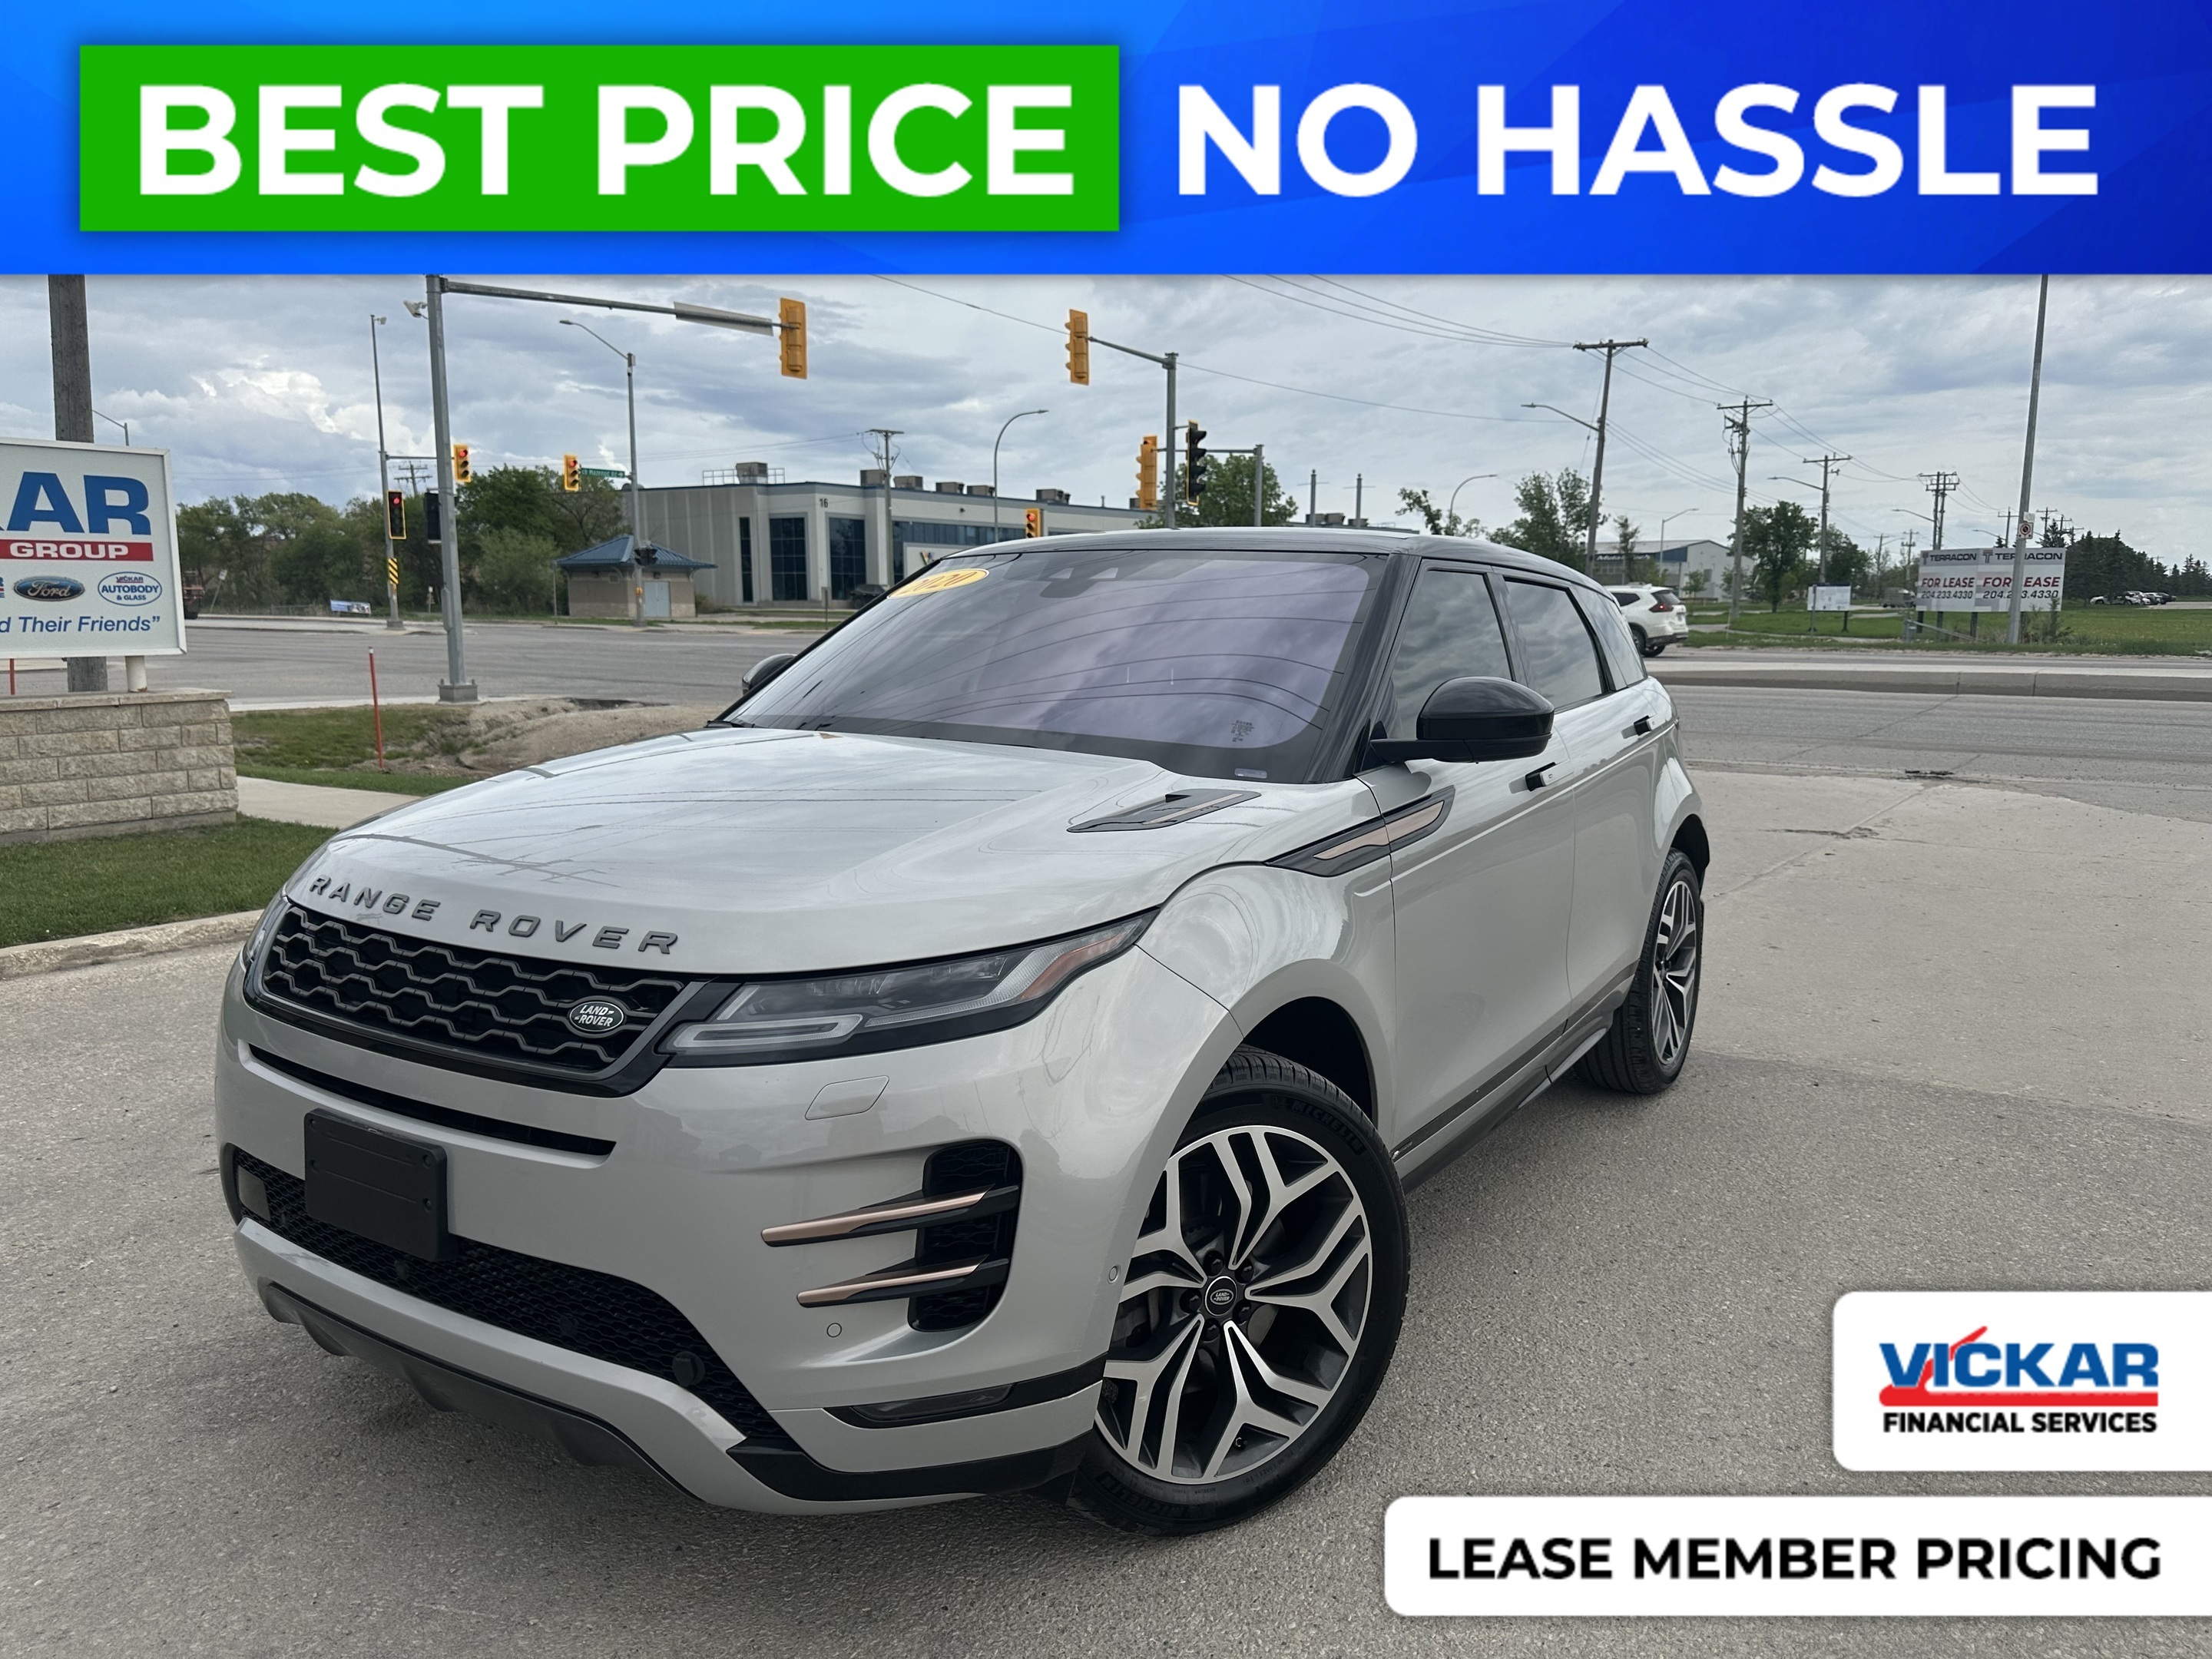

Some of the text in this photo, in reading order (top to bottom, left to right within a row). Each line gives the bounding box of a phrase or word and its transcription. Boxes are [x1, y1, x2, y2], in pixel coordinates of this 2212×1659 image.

[0, 472, 151, 535] AR
[819, 498, 829, 508] 16
[9, 541, 129, 559] GROUP
[1930, 553, 1977, 561] TERRACON
[1995, 552, 2063, 561] TERACON
[28, 579, 71, 597] Ford
[1922, 577, 1975, 588] FOR LEASE
[1982, 577, 2061, 588] FOR EASE
[101, 584, 159, 594] AUTOBODY
[1982, 590, 2059, 599] 204.23.4330
[18, 616, 71, 633] Their
[309, 874, 678, 955] RANGE ROVER
[578, 1015, 614, 1027] ROVER
[1290, 1100, 1364, 1154] MICHELIN
